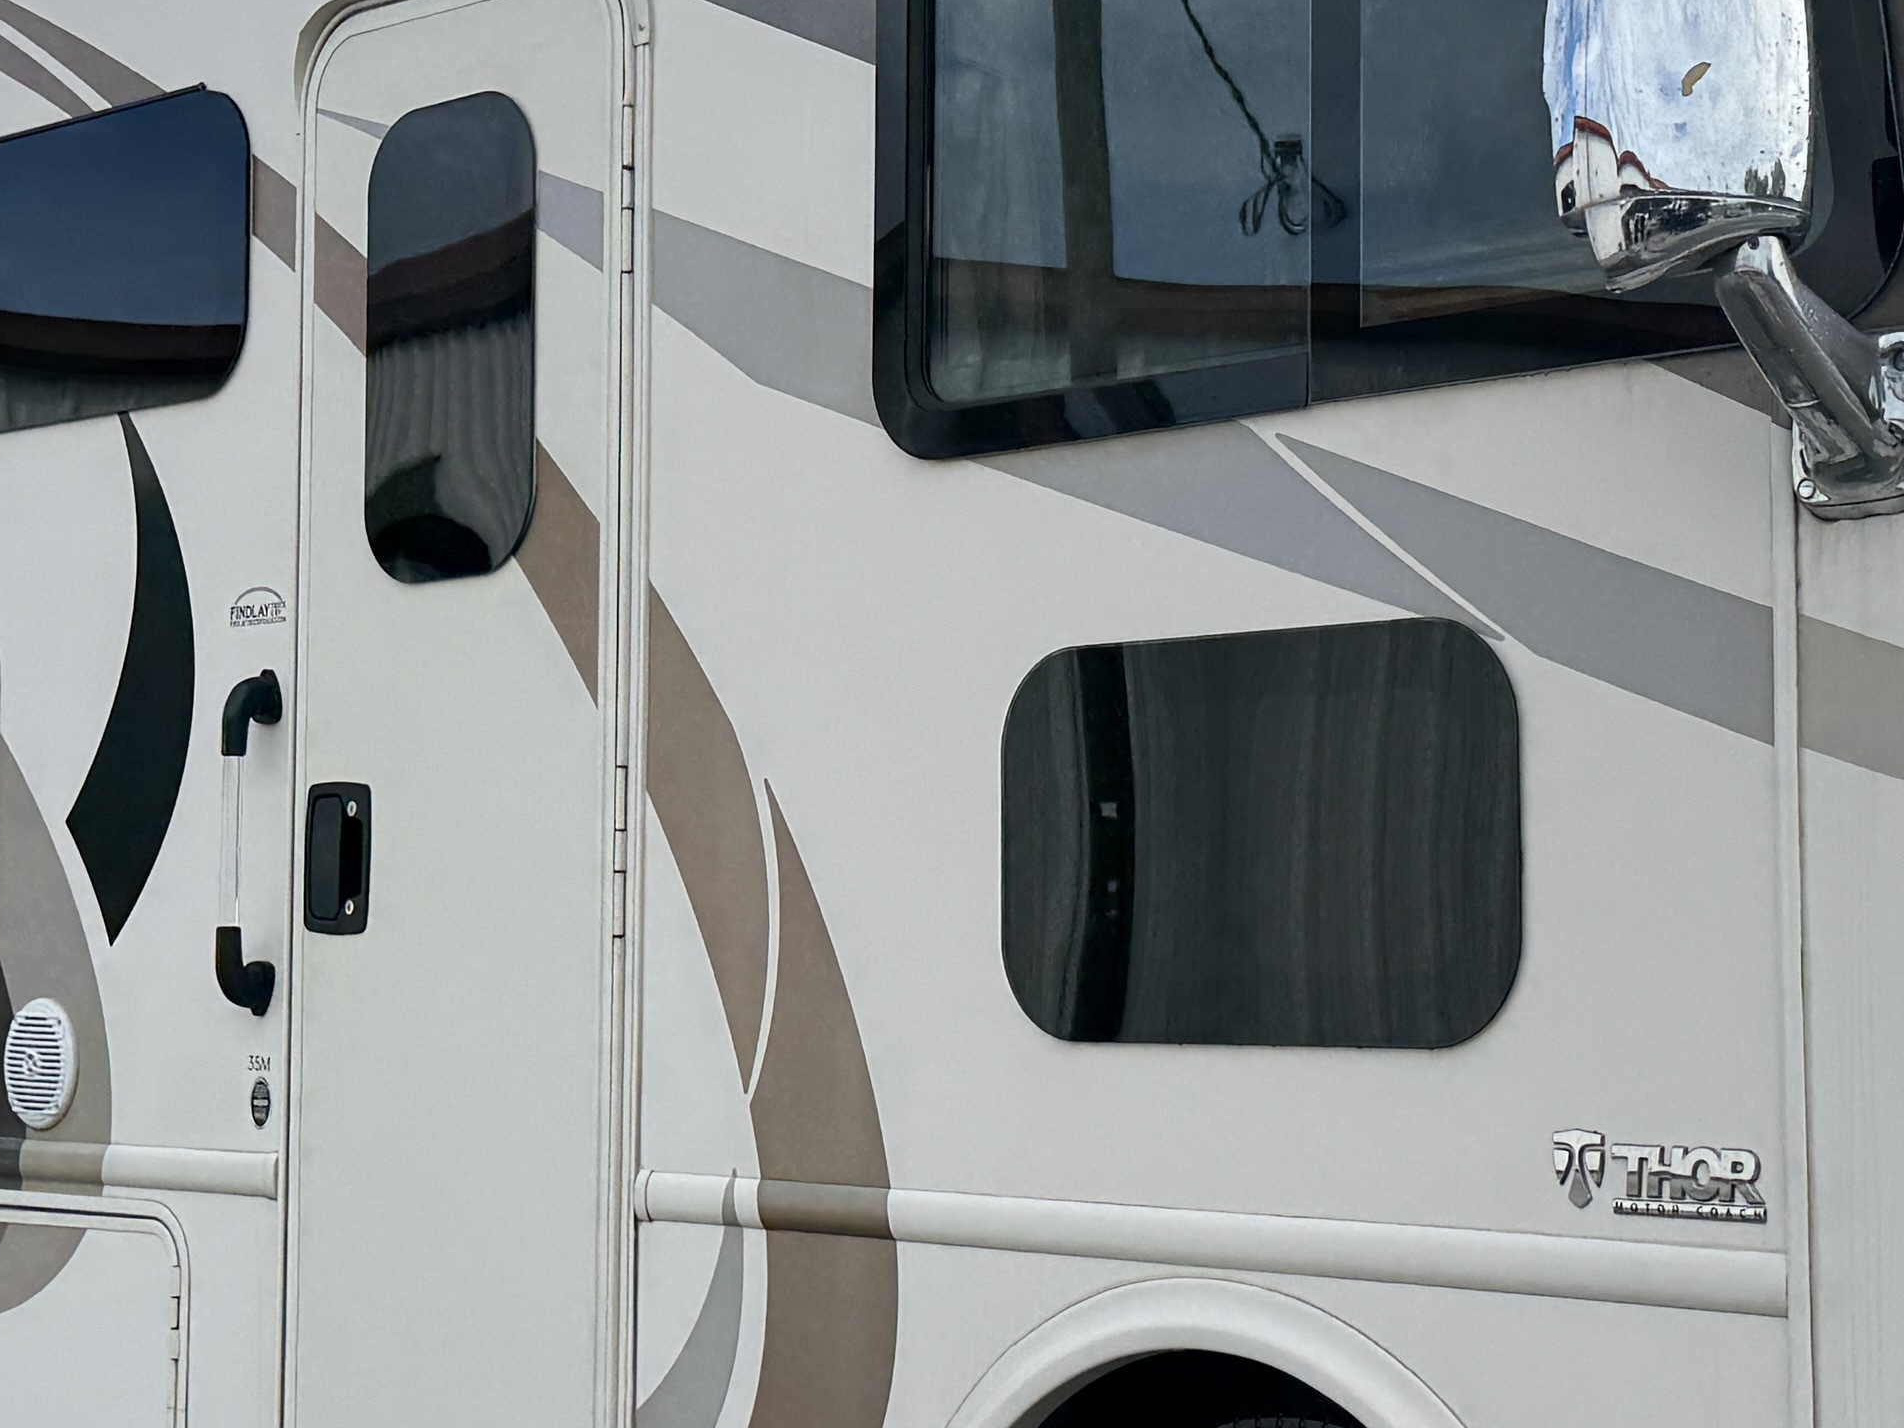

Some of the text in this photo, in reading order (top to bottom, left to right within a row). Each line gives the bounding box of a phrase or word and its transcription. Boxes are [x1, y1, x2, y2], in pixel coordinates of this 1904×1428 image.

[1611, 1143, 1765, 1205] THOR
[1614, 1200, 1763, 1220] MOTOR COACH
